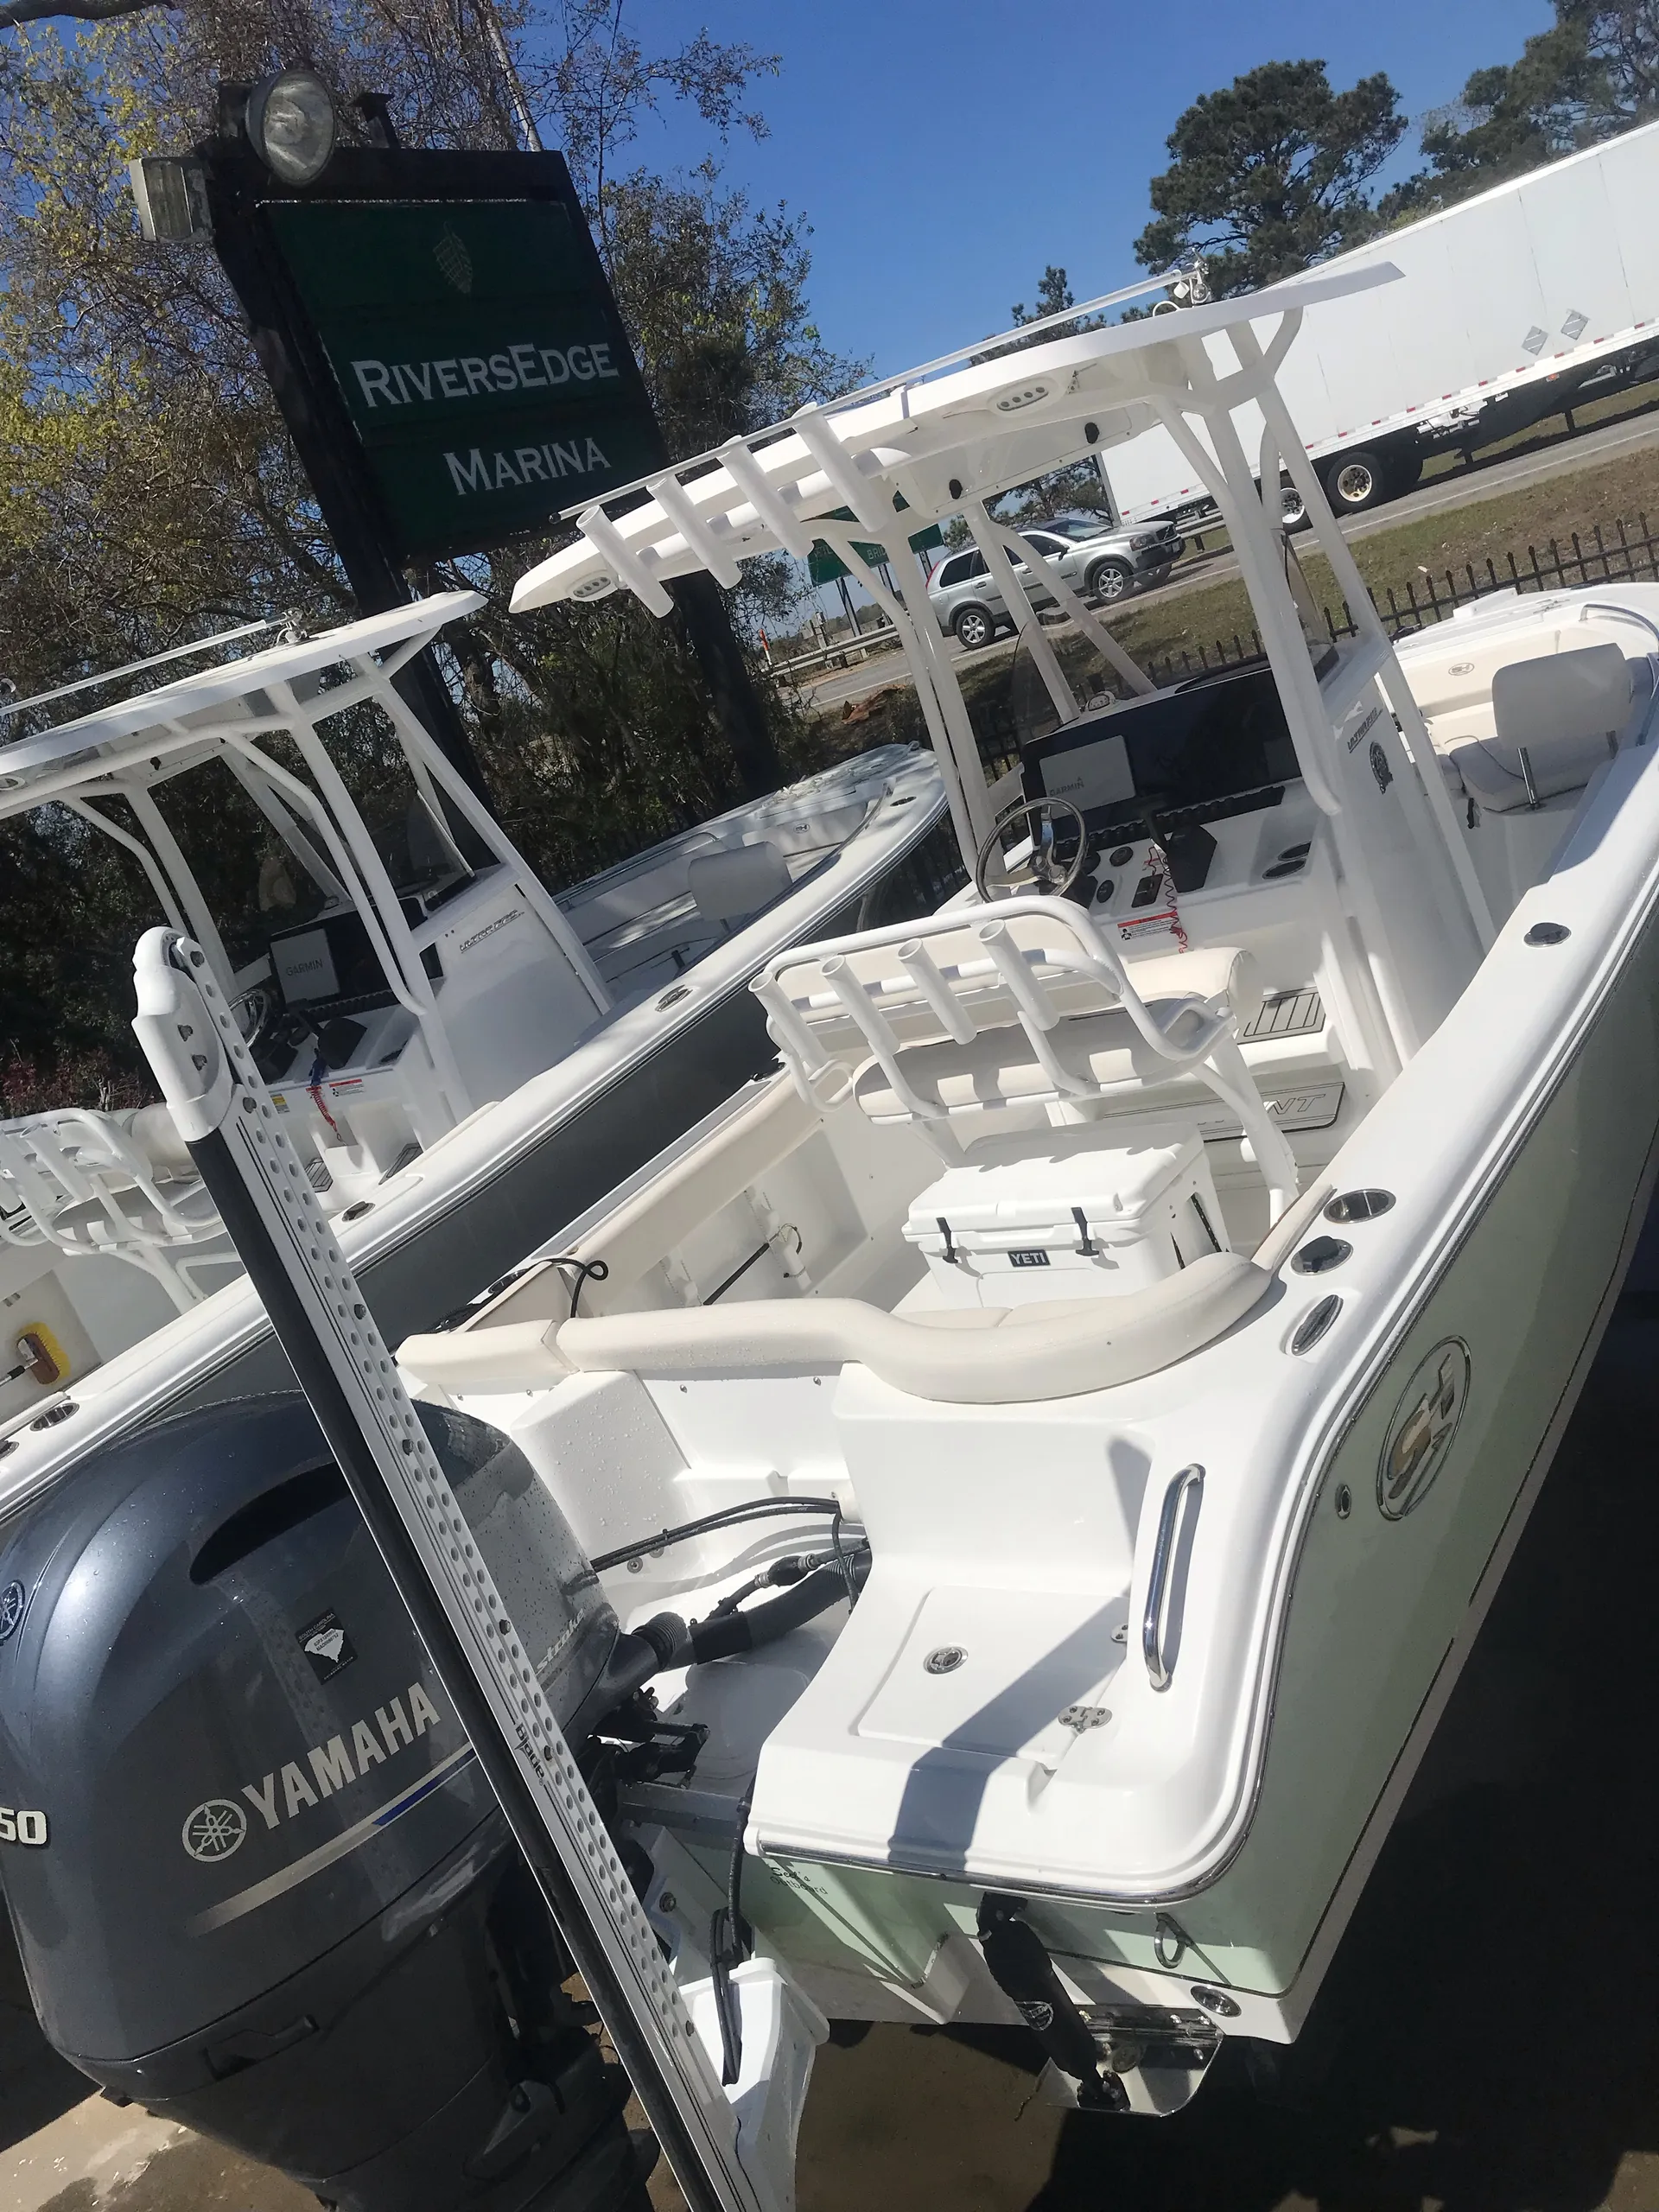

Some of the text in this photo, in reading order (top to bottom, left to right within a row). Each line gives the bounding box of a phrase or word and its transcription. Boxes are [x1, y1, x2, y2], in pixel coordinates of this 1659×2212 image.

[286, 958, 324, 976] GARMIN
[1011, 1252, 1046, 1264] YETI
[537, 1608, 585, 1670] stroke
[241, 1682, 441, 1829] YAMAHA
